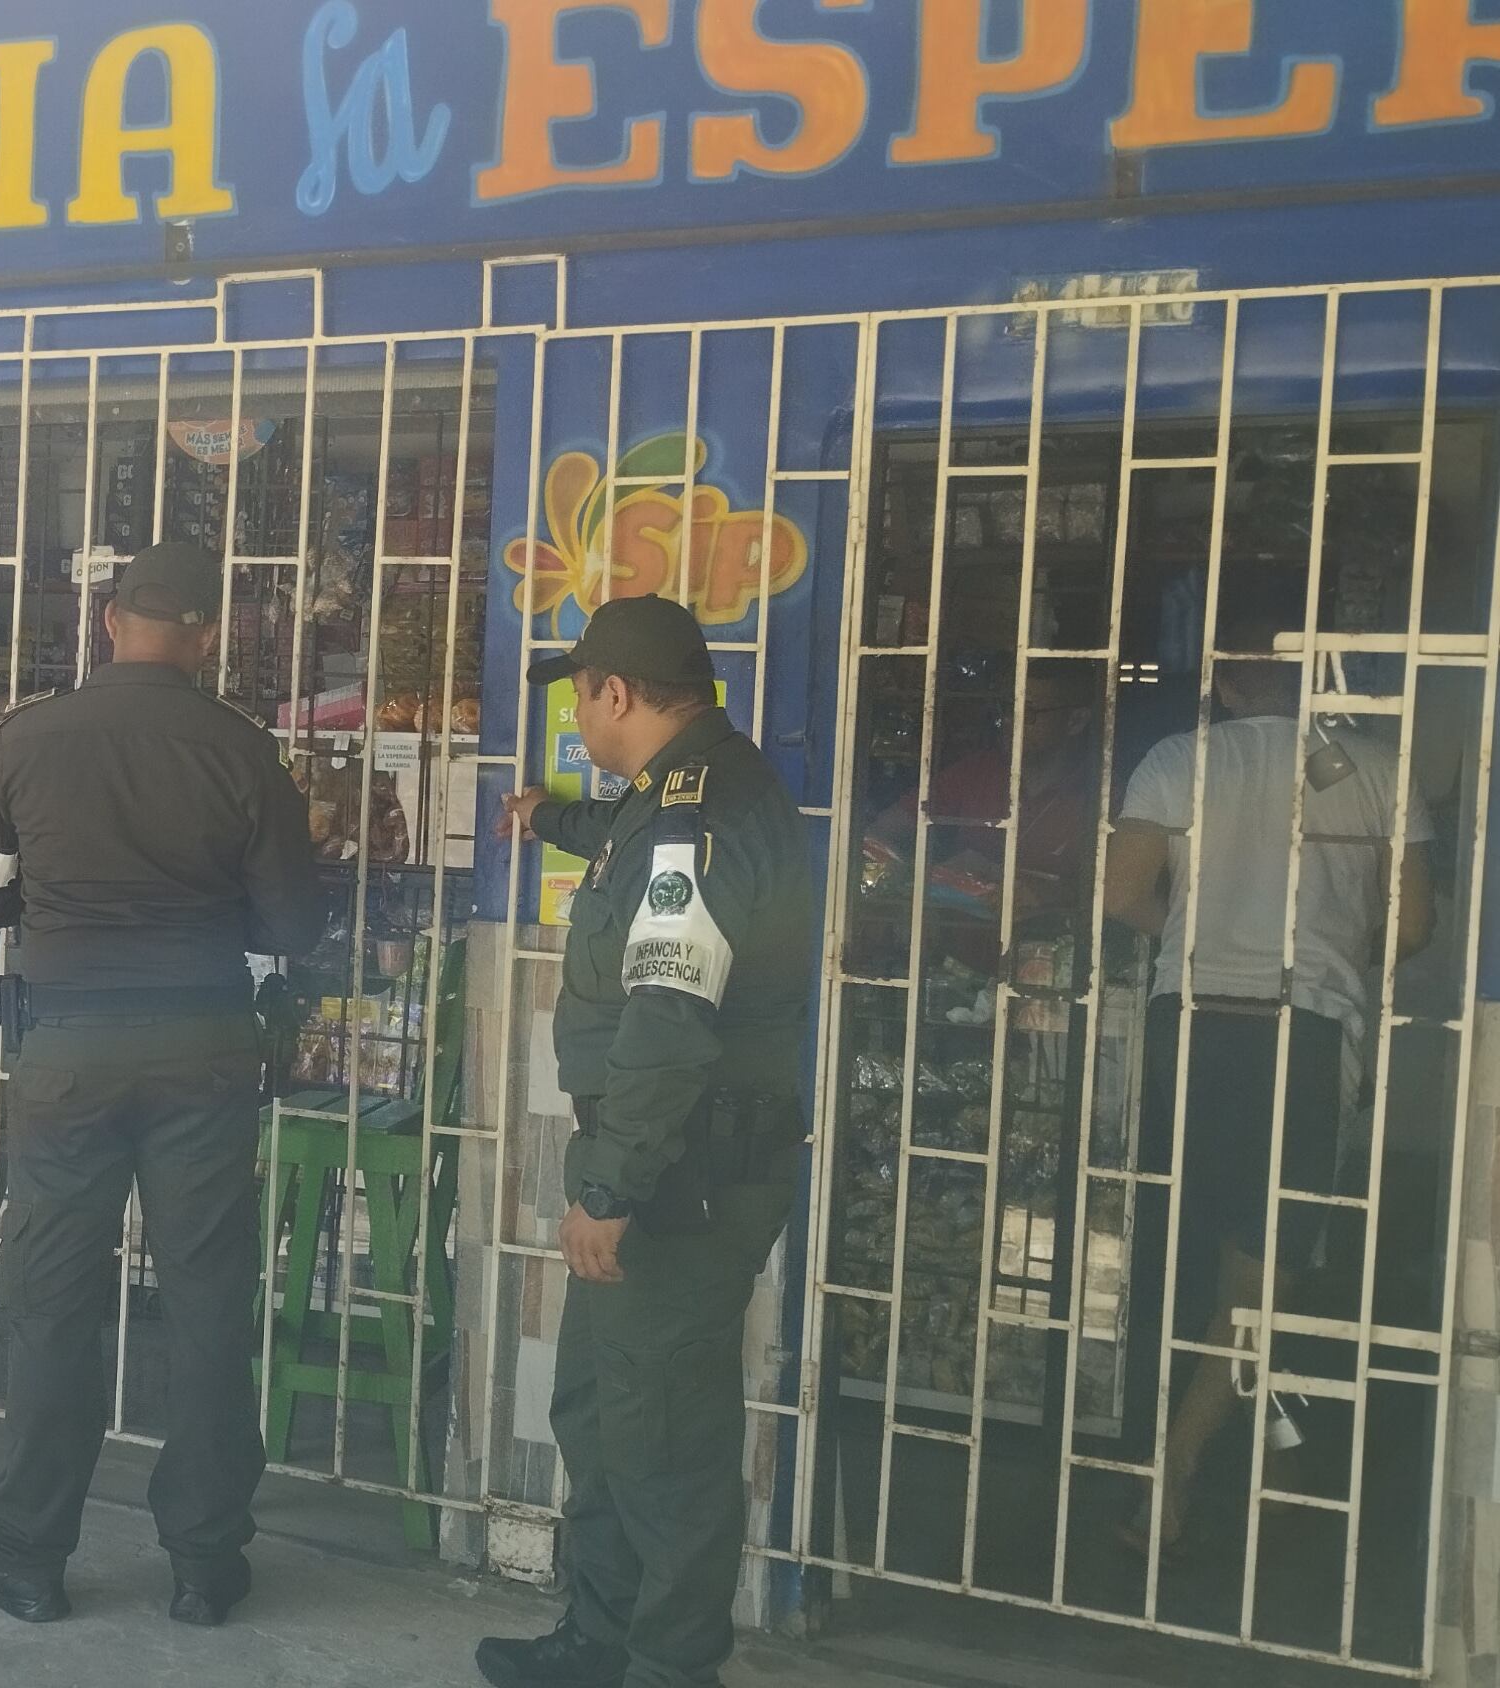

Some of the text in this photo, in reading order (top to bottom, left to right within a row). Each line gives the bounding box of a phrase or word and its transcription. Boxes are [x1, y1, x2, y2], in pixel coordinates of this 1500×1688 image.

[588, 491, 799, 615] Sip
[558, 708, 577, 723] SI
[635, 941, 694, 960] INFANCIA Y
